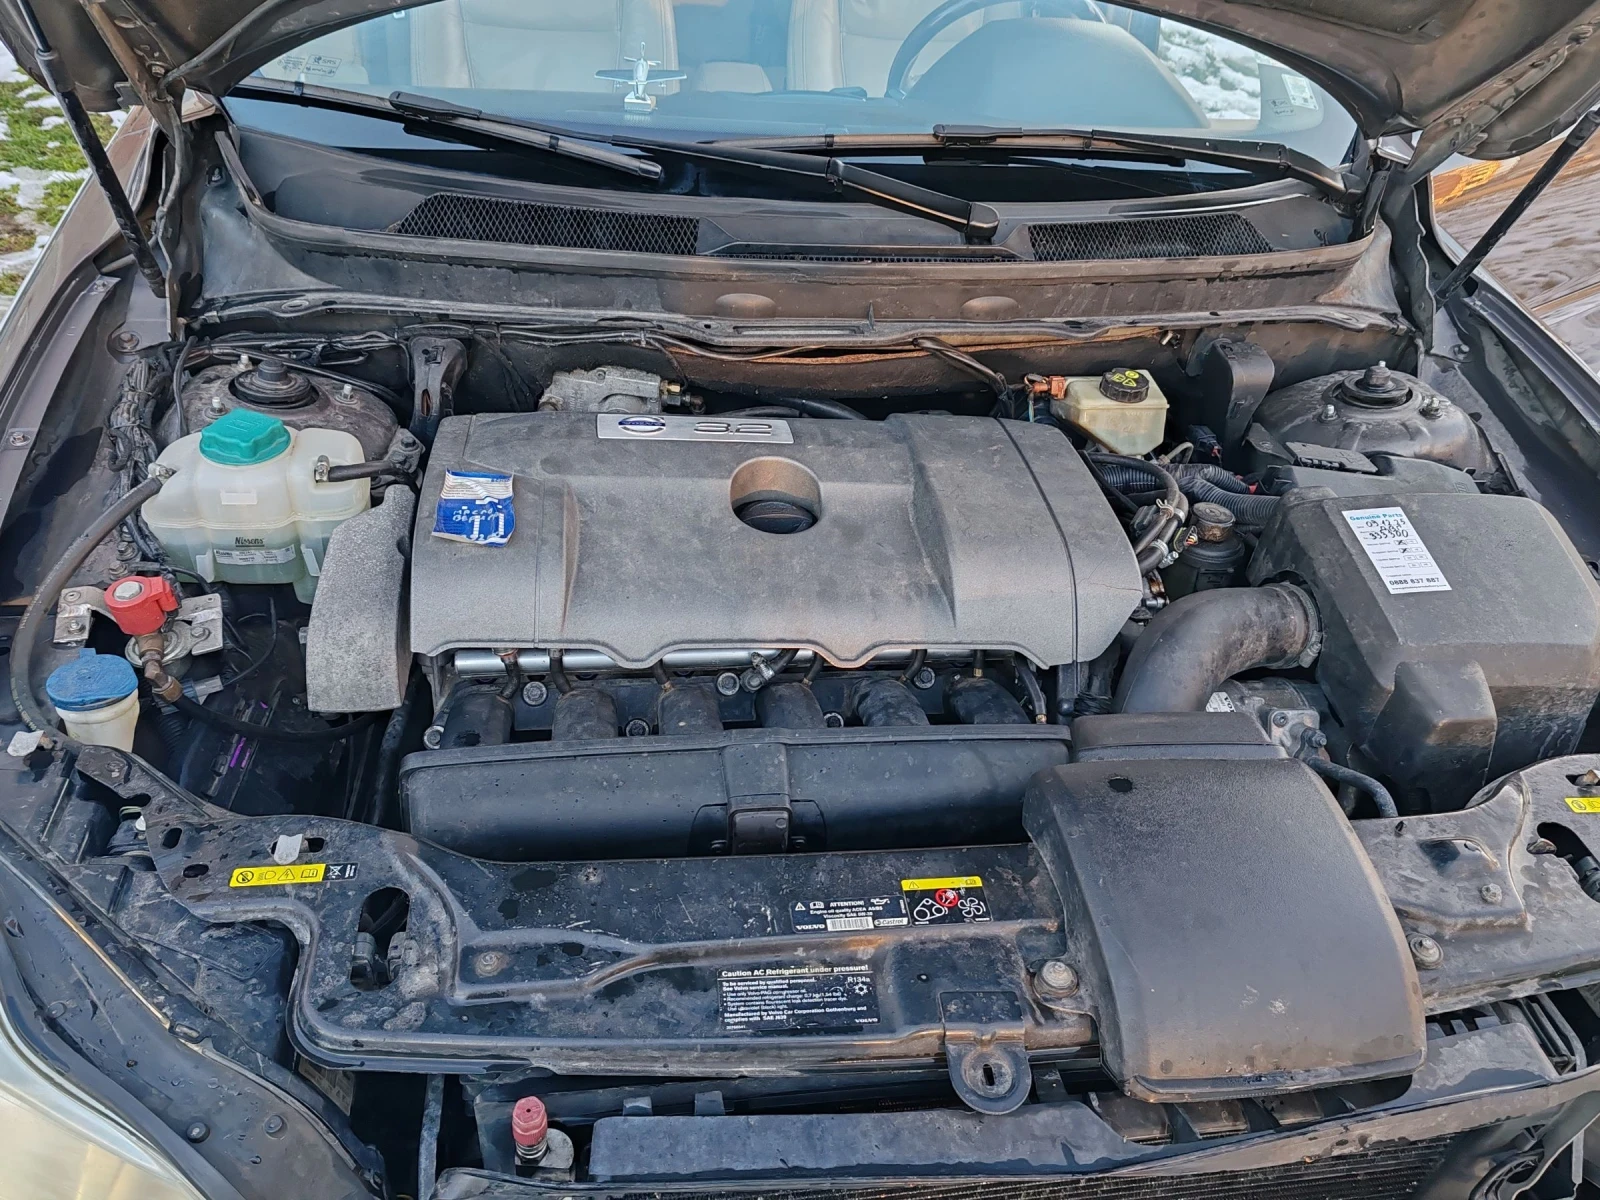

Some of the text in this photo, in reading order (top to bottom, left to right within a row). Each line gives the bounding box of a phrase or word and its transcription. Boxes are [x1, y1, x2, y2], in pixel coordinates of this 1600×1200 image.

[693, 421, 773, 436] 3.2
[234, 536, 264, 545] Nissens
[766, 968, 808, 976] Refrigerant
[834, 964, 869, 974] pressure!
